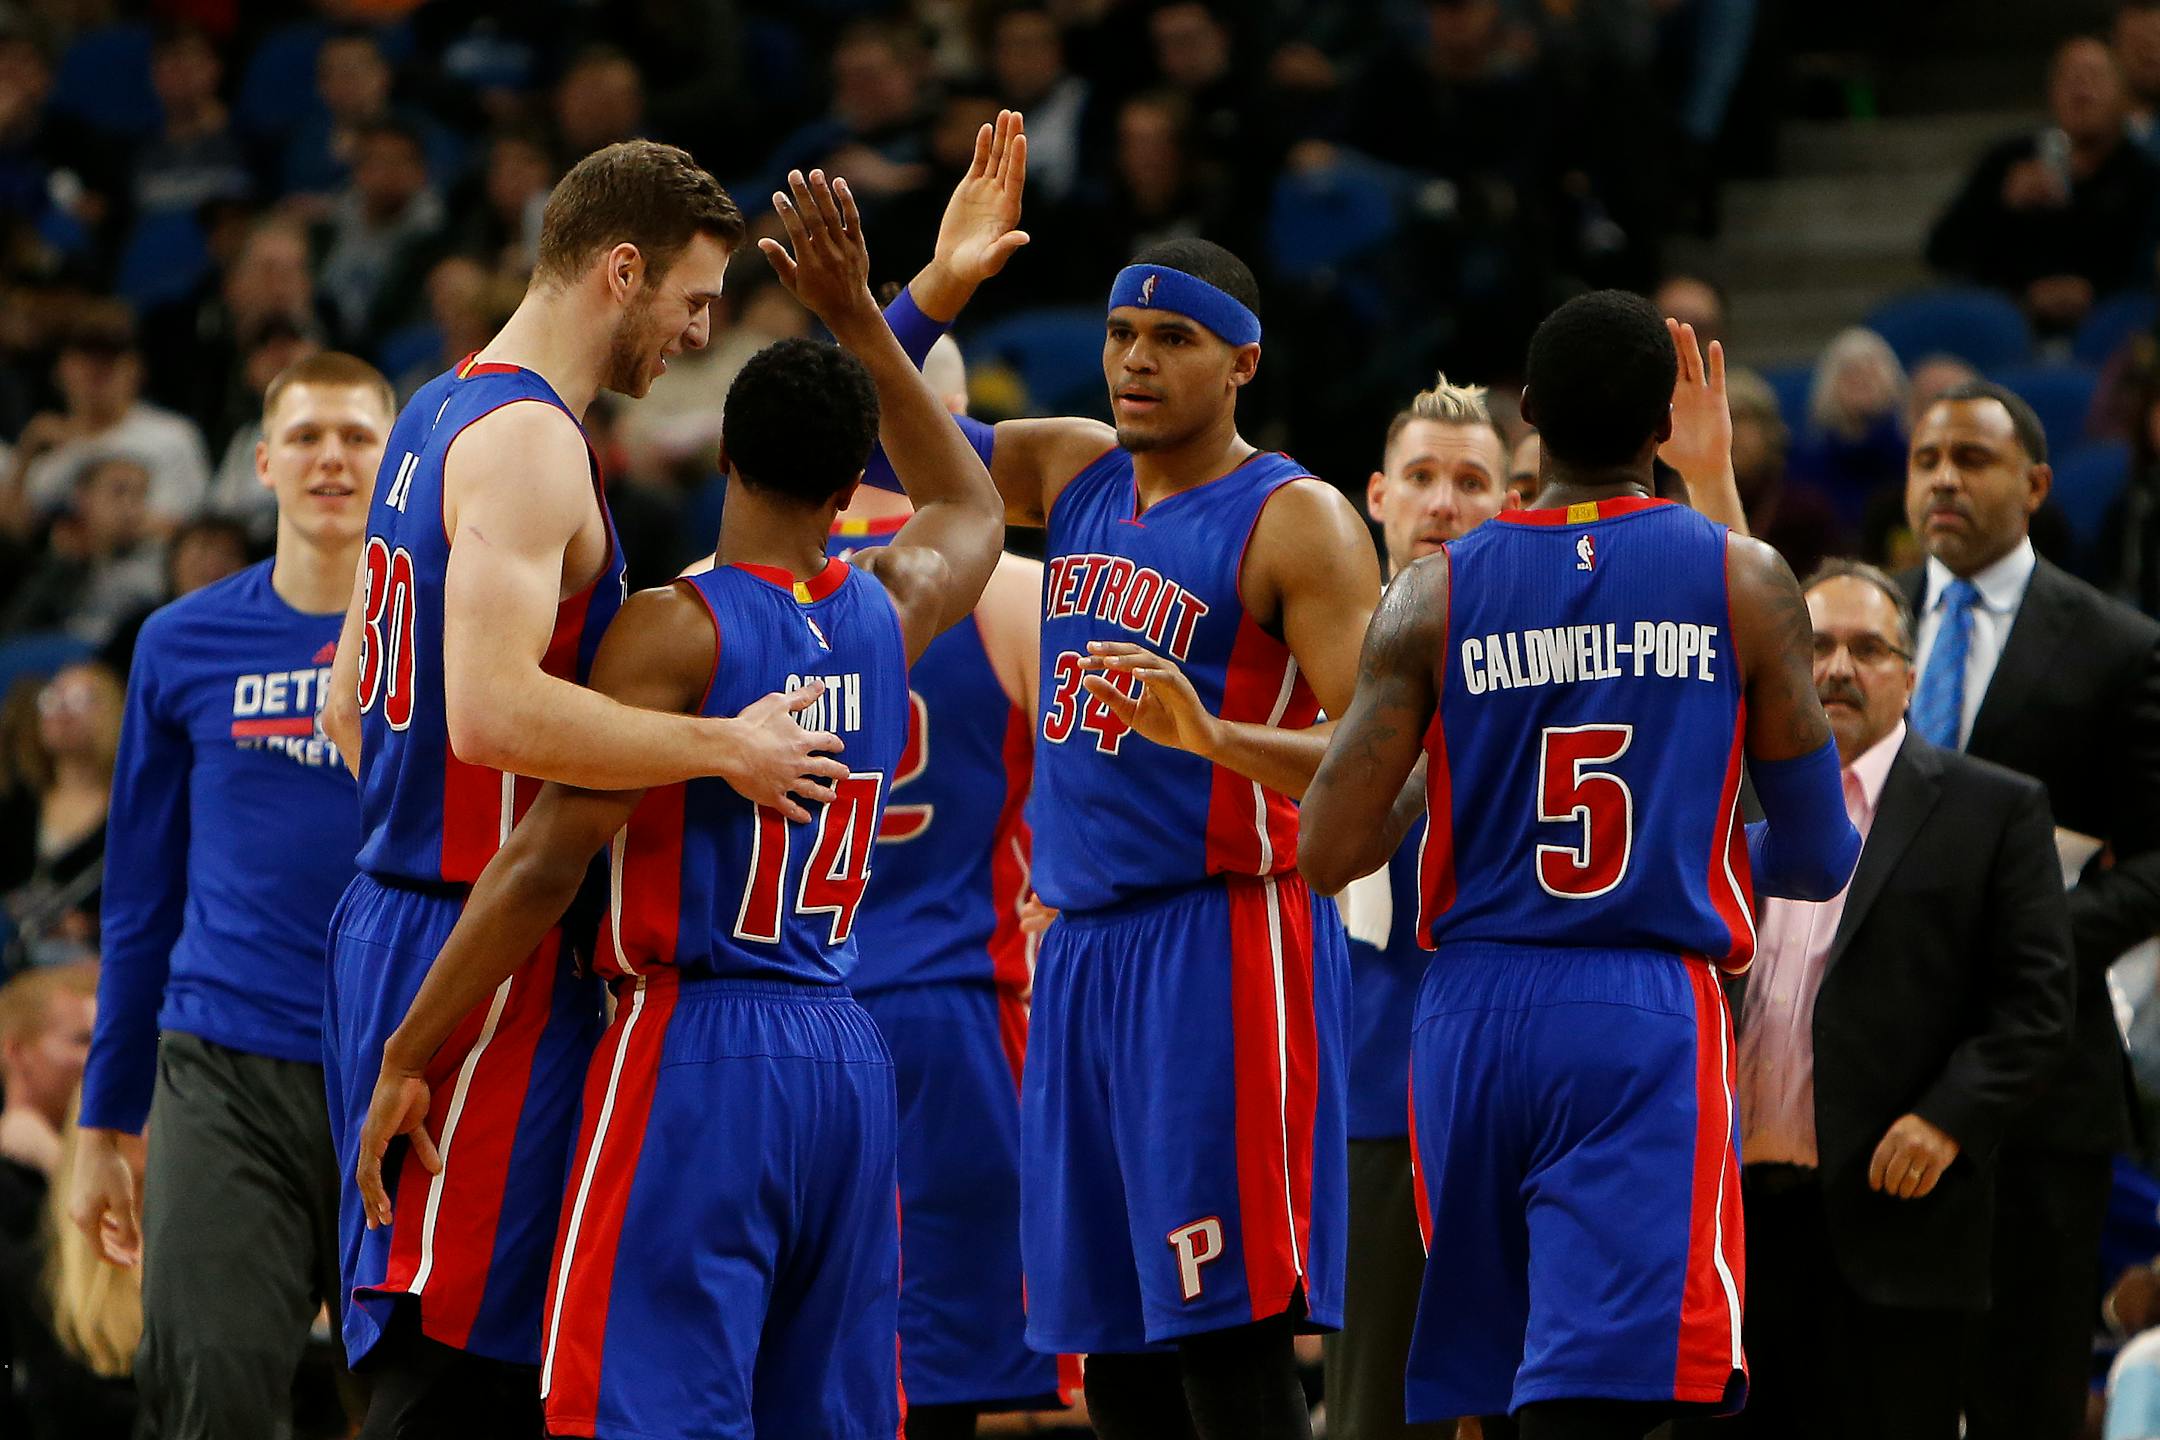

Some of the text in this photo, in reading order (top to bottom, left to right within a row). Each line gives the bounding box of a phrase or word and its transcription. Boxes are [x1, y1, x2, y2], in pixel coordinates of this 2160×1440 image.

[357, 536, 416, 731] 30
[1461, 621, 1718, 695] CALDWELL-POPE
[1043, 651, 1147, 756] 34
[733, 772, 884, 946] 14
[1536, 724, 1634, 899] 5
[1166, 1215, 1225, 1302] P
